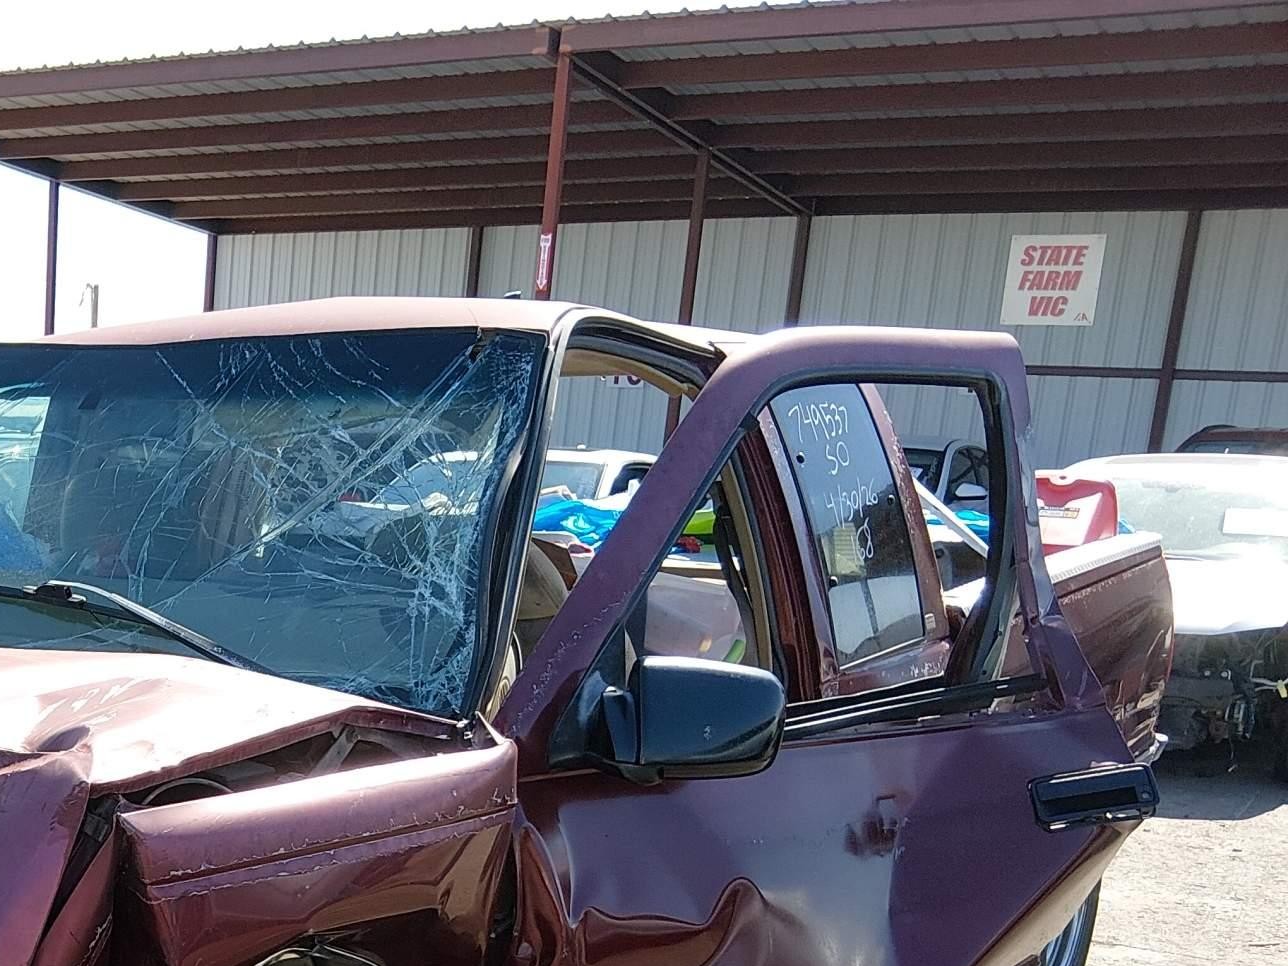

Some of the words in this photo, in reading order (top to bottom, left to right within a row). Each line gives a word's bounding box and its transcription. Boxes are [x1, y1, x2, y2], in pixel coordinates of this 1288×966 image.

[1020, 245, 1089, 267] STATE
[1017, 270, 1083, 291] FARM
[1028, 295, 1069, 317] VIC
[788, 402, 848, 443] 749537
[823, 477, 879, 529] 4/30/26
